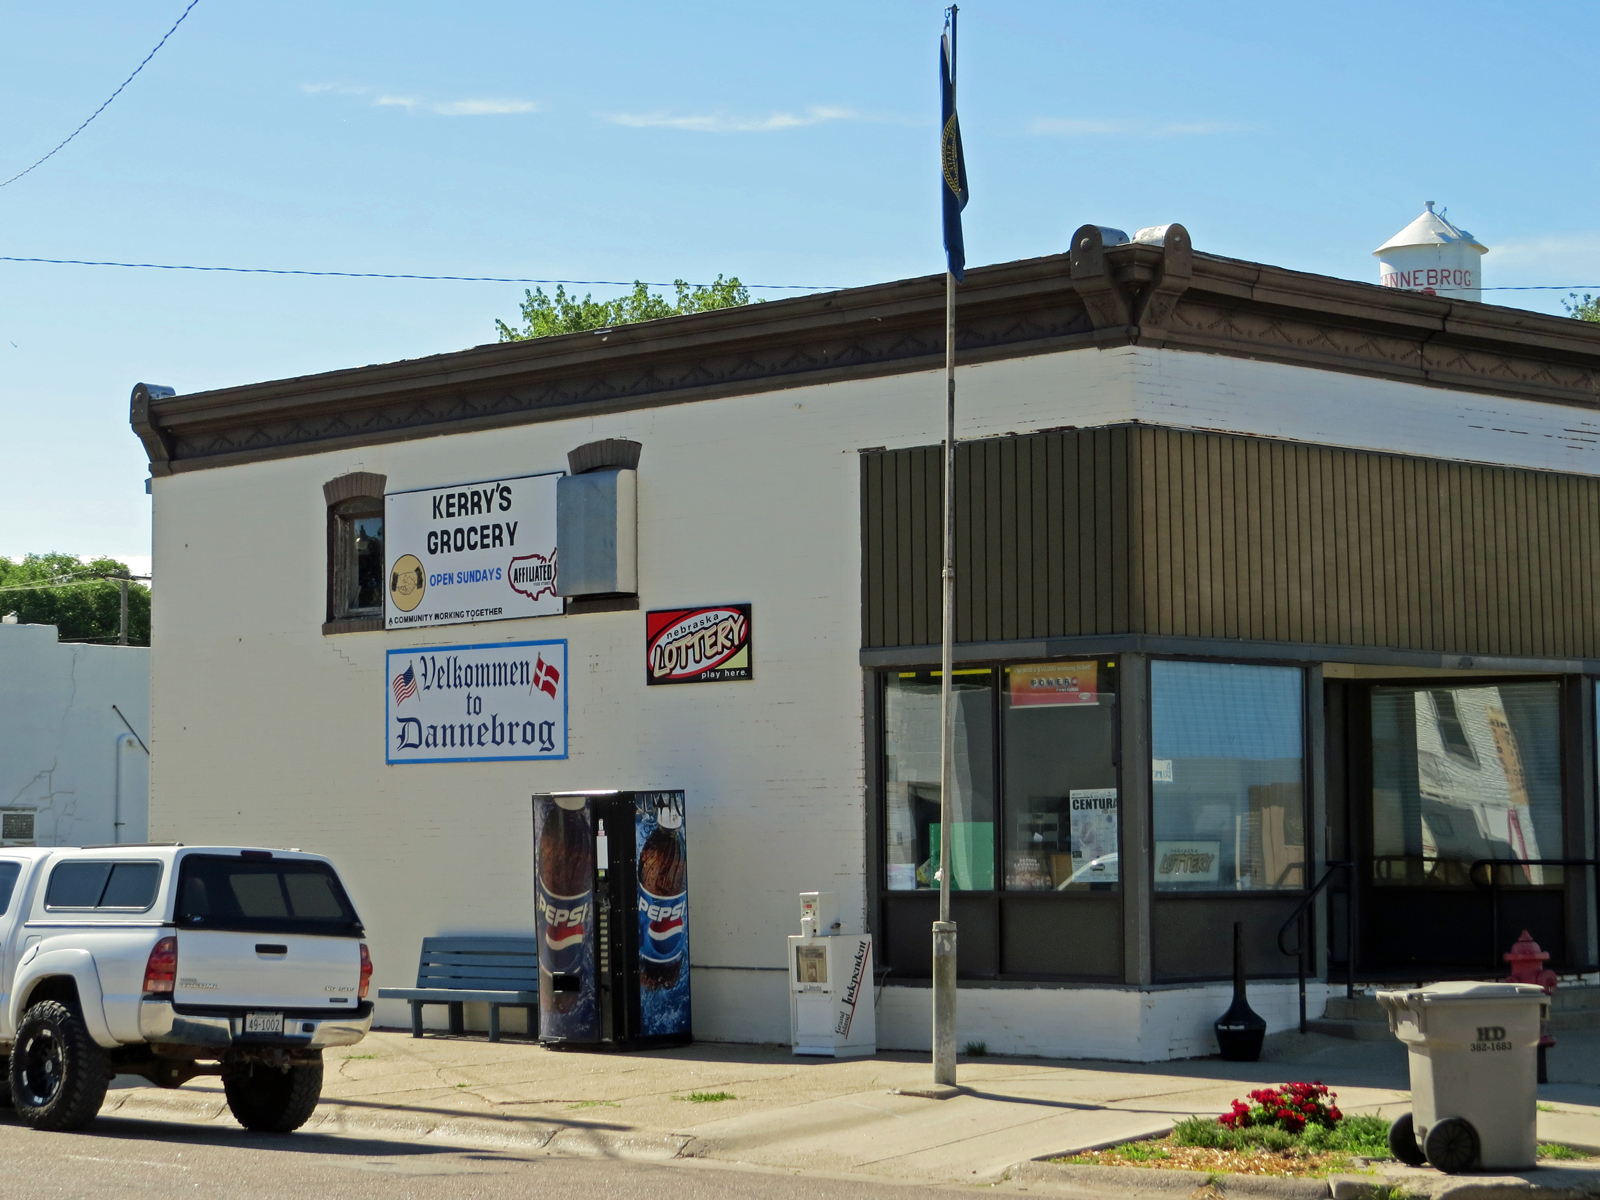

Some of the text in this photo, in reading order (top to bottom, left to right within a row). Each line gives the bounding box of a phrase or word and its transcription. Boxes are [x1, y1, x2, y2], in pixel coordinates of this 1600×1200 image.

[433, 482, 512, 519] KERRY'S
[427, 521, 518, 555] GROCERY
[430, 567, 502, 587] OPEN SUNDAYS
[514, 564, 552, 583] AFFILIATED
[388, 607, 503, 625] A COMMUNITY WORKING TOGETHER
[666, 613, 719, 640] nebraska
[653, 613, 745, 678] LOTTERY
[420, 655, 531, 691] Velkommen
[702, 669, 748, 680] play here.
[466, 691, 482, 716] to
[396, 713, 555, 752] Dannebrog
[1159, 853, 1215, 874] LOTTERY
[539, 892, 588, 927] PEPSI
[639, 896, 686, 922] PEPSI
[841, 940, 866, 1007] Independent
[249, 1018, 280, 1031] 49-1002
[835, 1011, 845, 1034] Grand
[840, 1014, 850, 1036] Island
[1477, 1026, 1506, 1041] HD
[1470, 1041, 1512, 1051] 382-1683
